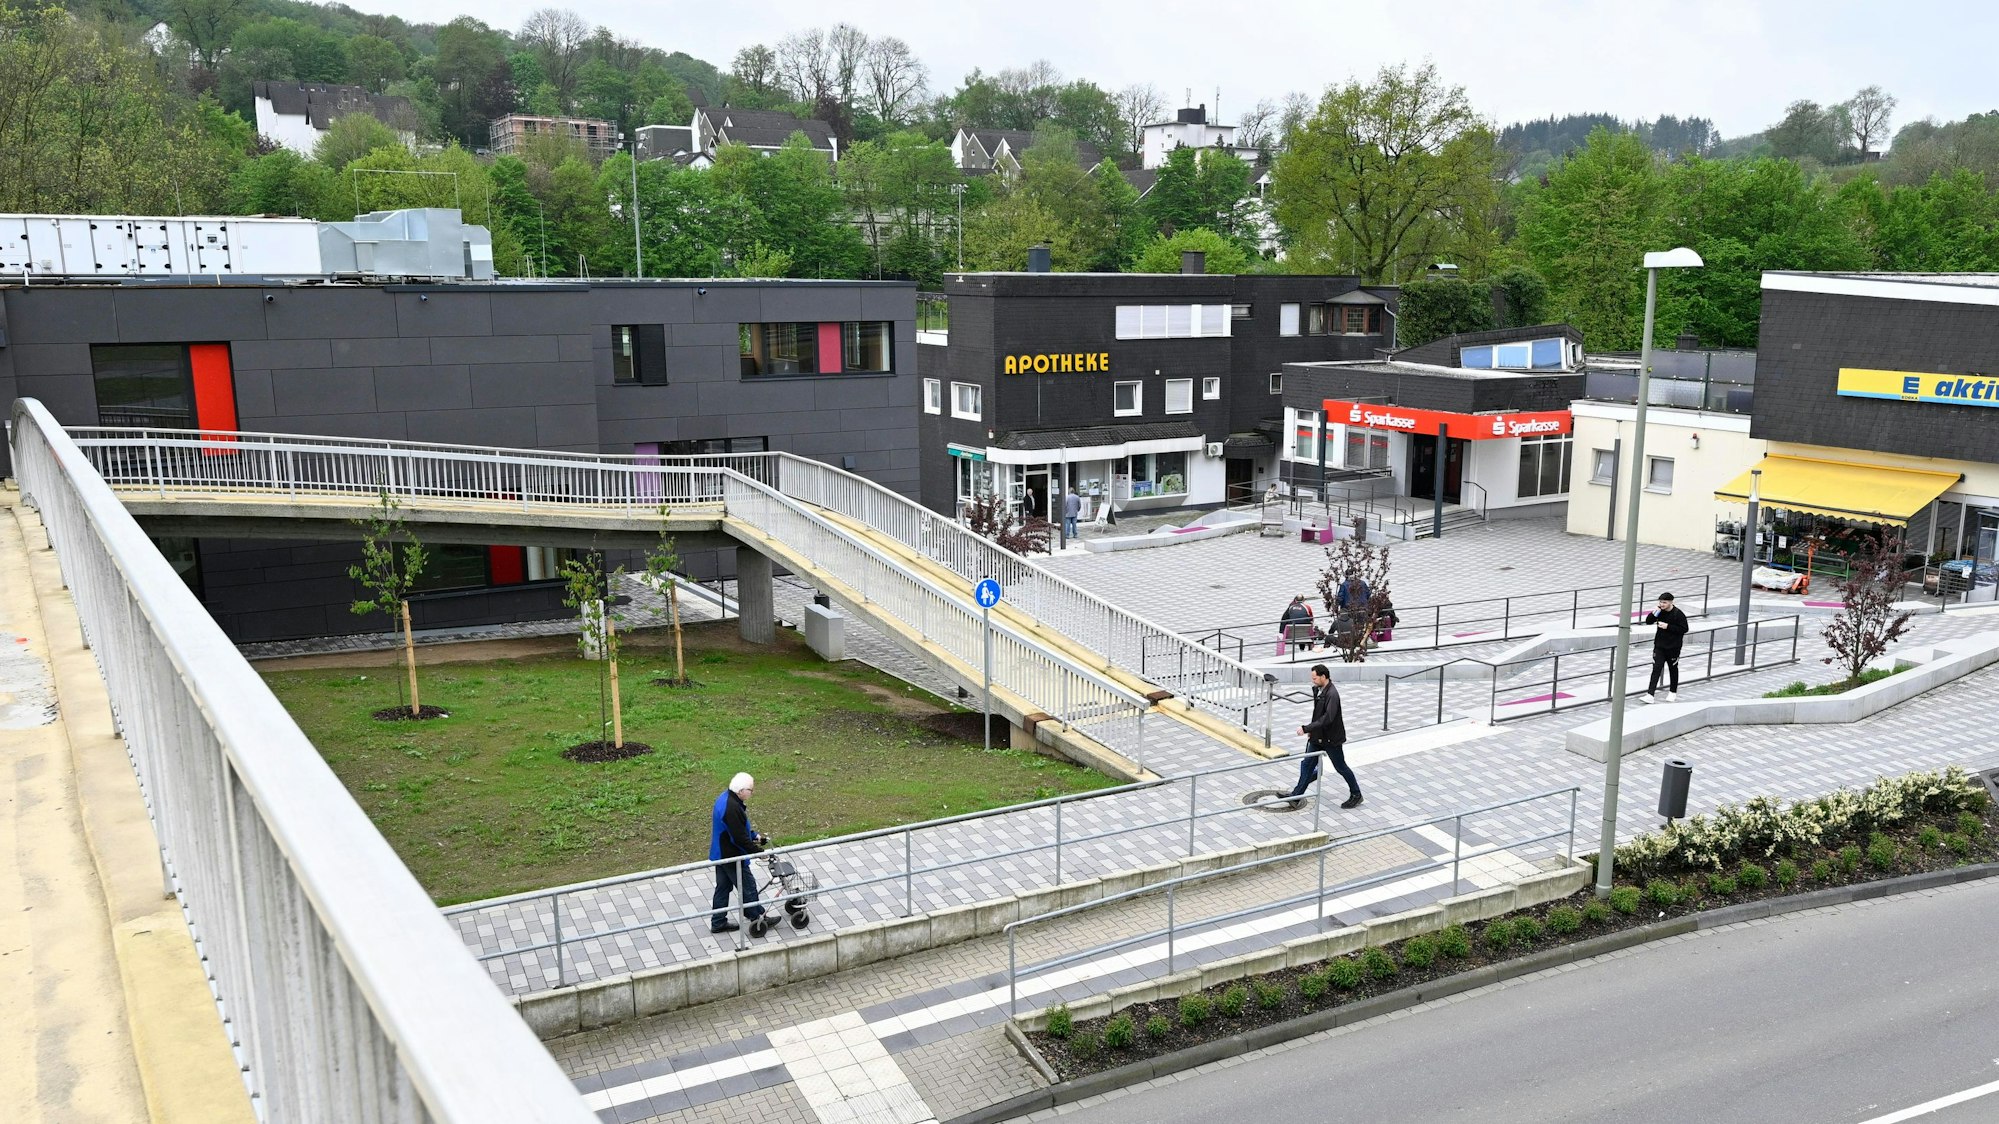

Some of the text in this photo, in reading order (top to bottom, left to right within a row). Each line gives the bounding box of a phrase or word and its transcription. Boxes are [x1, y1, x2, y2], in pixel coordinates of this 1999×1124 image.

[1004, 353, 1109, 374] APOTHEKE
[1935, 379, 1999, 400] akti
[1364, 406, 1415, 428] Sparkasse
[1508, 419, 1560, 436] Sparkasse
